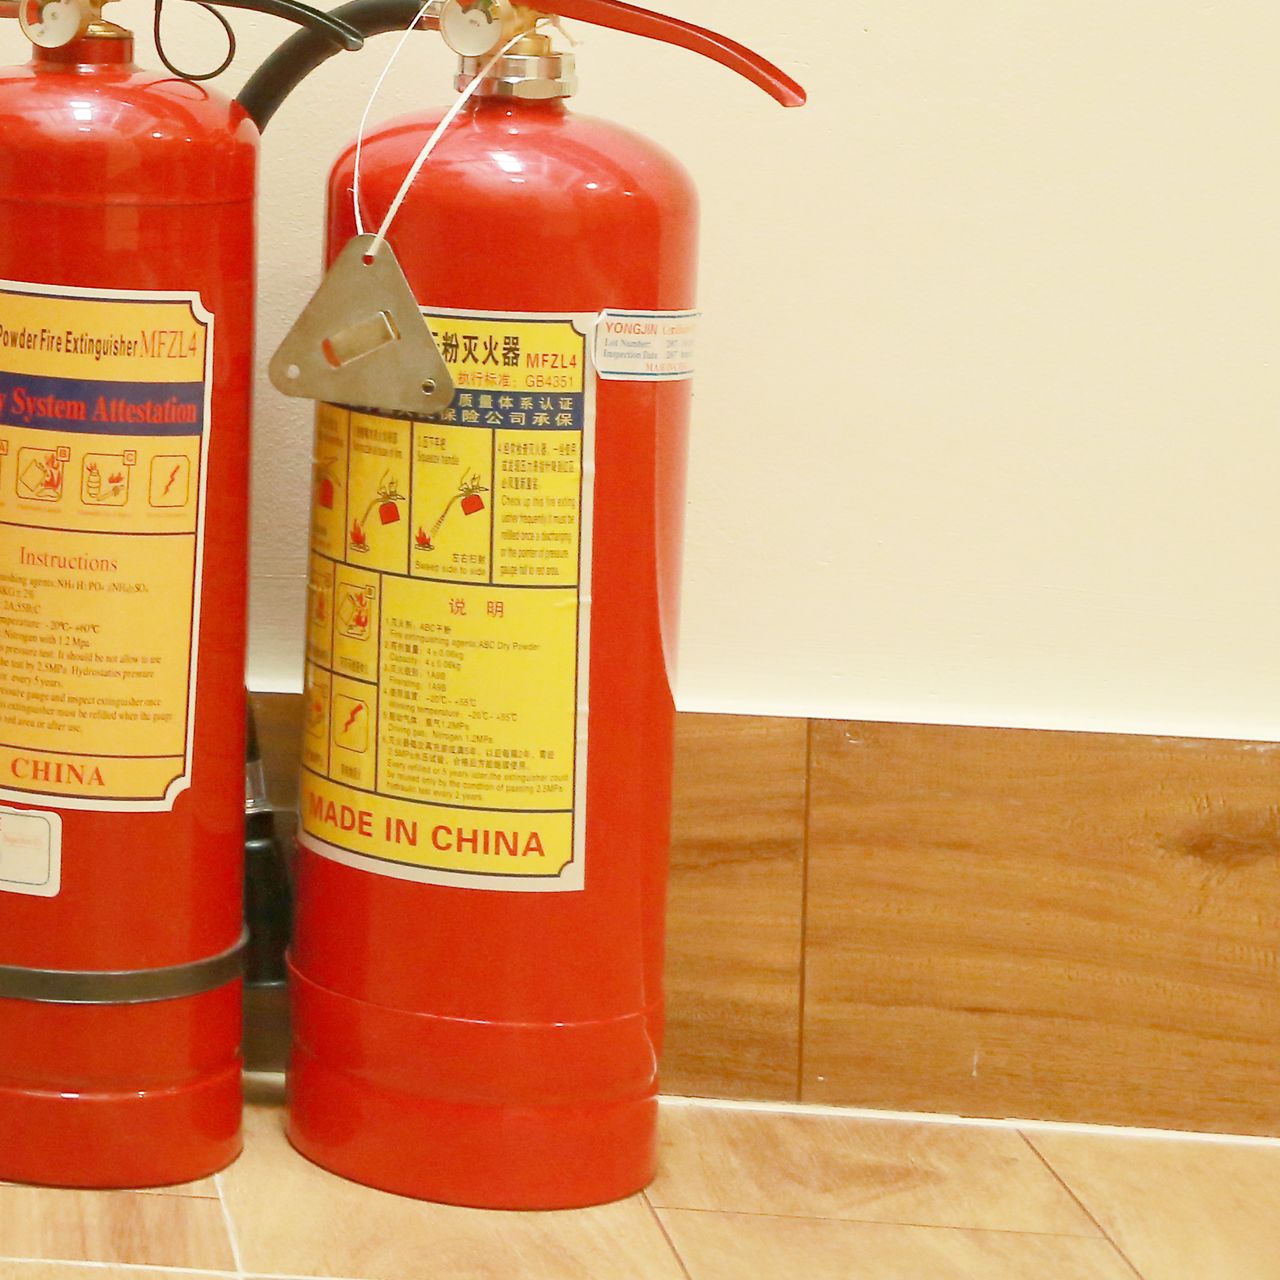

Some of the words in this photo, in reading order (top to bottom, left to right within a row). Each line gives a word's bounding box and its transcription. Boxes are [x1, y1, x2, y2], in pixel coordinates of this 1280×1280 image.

[605, 322, 657, 335] YONGJIN
[40, 328, 62, 352] Fire
[66, 331, 138, 361] Extinguisher
[140, 330, 198, 359] MFZL4
[526, 353, 577, 369] MFZL4
[12, 387, 87, 422] System
[92, 394, 197, 424] Attestation
[459, 393, 573, 410] 质量体系认证
[20, 546, 118, 571] Instructions
[11, 756, 105, 786] CHINA
[308, 791, 374, 838] MADE
[385, 816, 418, 846] IN
[431, 824, 546, 857] CHINA
